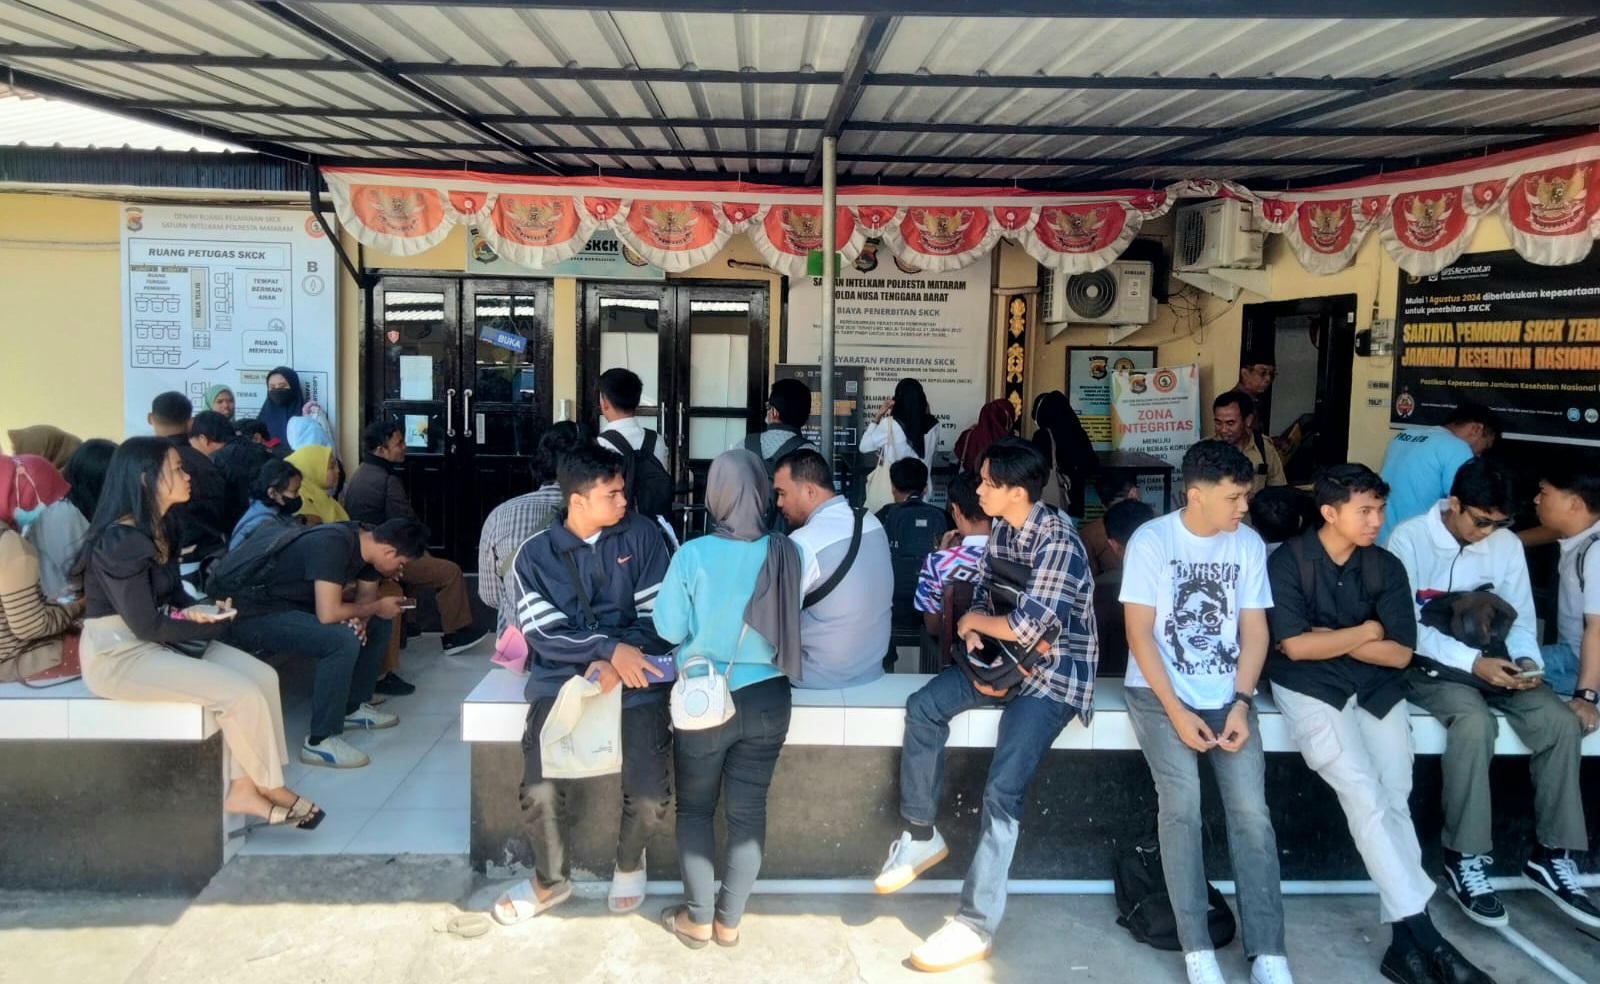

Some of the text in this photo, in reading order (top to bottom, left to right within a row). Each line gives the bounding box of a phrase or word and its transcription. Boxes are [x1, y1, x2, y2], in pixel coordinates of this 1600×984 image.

[585, 240, 618, 251] SKCK
[148, 248, 266, 260] RUANG PETUGAS SKCK
[307, 261, 318, 272] B
[813, 277, 966, 290] SAAN INTELKAM POLRESTA MATARAM
[834, 290, 949, 302] OLDA NUSA TENGGARA BARAT
[1405, 296, 1424, 305] Mulai
[1430, 295, 1460, 305] Agustus
[1462, 294, 1482, 302] 2024
[1482, 291, 1538, 300] diberlakukan
[1540, 286, 1600, 299] kepesertaan
[864, 308, 916, 316] PENERBITAN
[1405, 304, 1491, 316] untuk penerbitan SKCK
[1404, 322, 1454, 343] SAATNYA
[1456, 321, 1522, 342] PEMOHON
[1524, 320, 1566, 342] SKCK
[498, 334, 520, 348] BUKA
[818, 356, 878, 364] PSYARATAN
[934, 358, 956, 366] SKCK
[1402, 346, 1600, 370] JAMINAN KESEHATAN NASIONA
[1520, 382, 1560, 390] Kesehatan
[1561, 383, 1596, 392] Nasional
[1138, 409, 1173, 420] ZONA
[1120, 420, 1194, 434] INTEGRITAS
